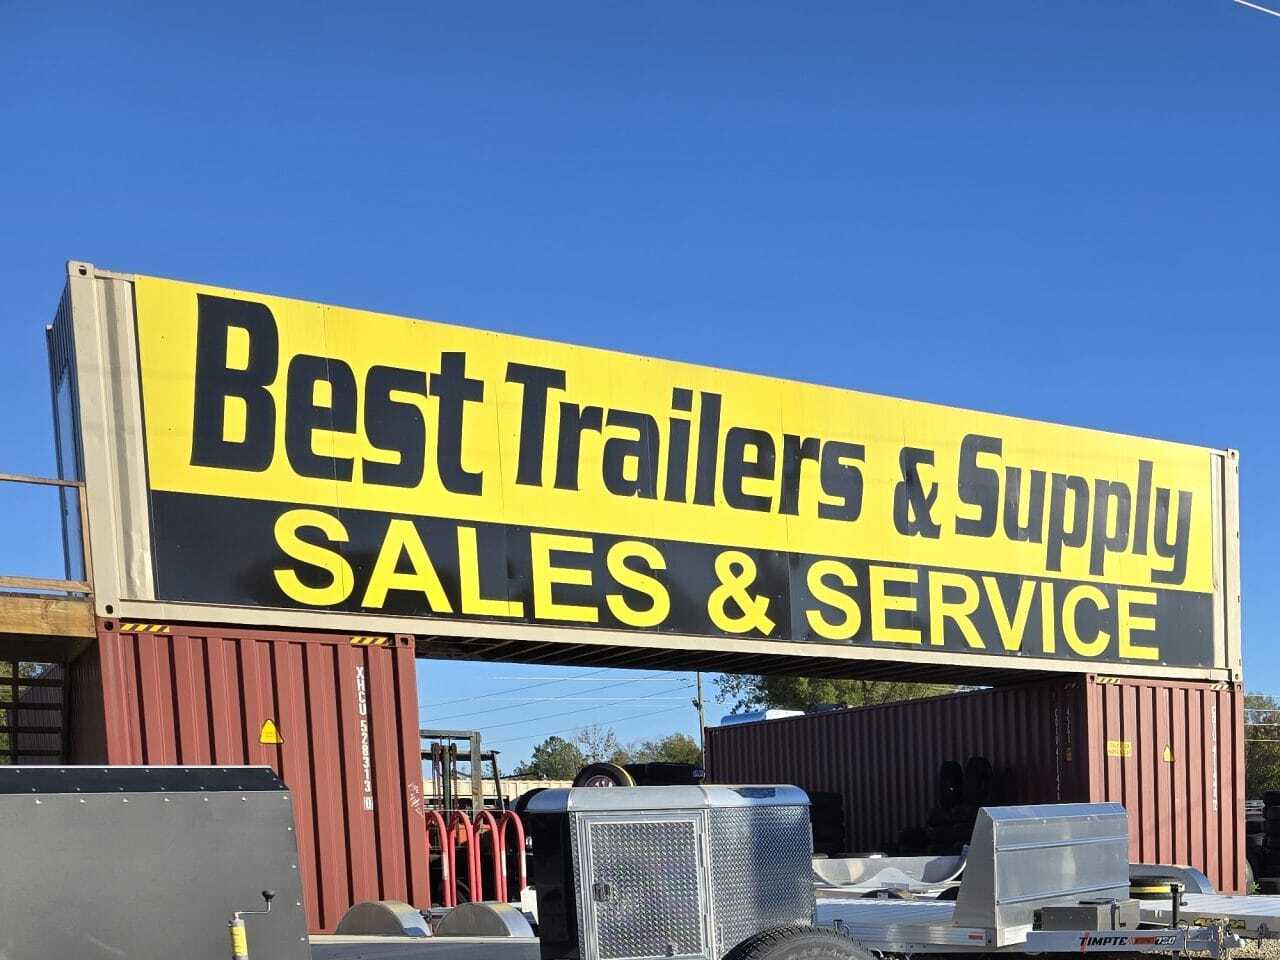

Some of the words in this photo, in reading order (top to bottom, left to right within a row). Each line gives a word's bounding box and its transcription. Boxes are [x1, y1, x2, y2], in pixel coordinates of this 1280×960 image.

[190, 293, 485, 496] Best
[504, 361, 866, 522] Trailers
[893, 446, 942, 539] &
[954, 433, 1193, 584] Supply
[274, 509, 671, 627] SALES
[707, 550, 776, 637] &
[805, 560, 1161, 661] SERVICE
[355, 666, 367, 716] XHCU
[360, 719, 371, 793] 528313
